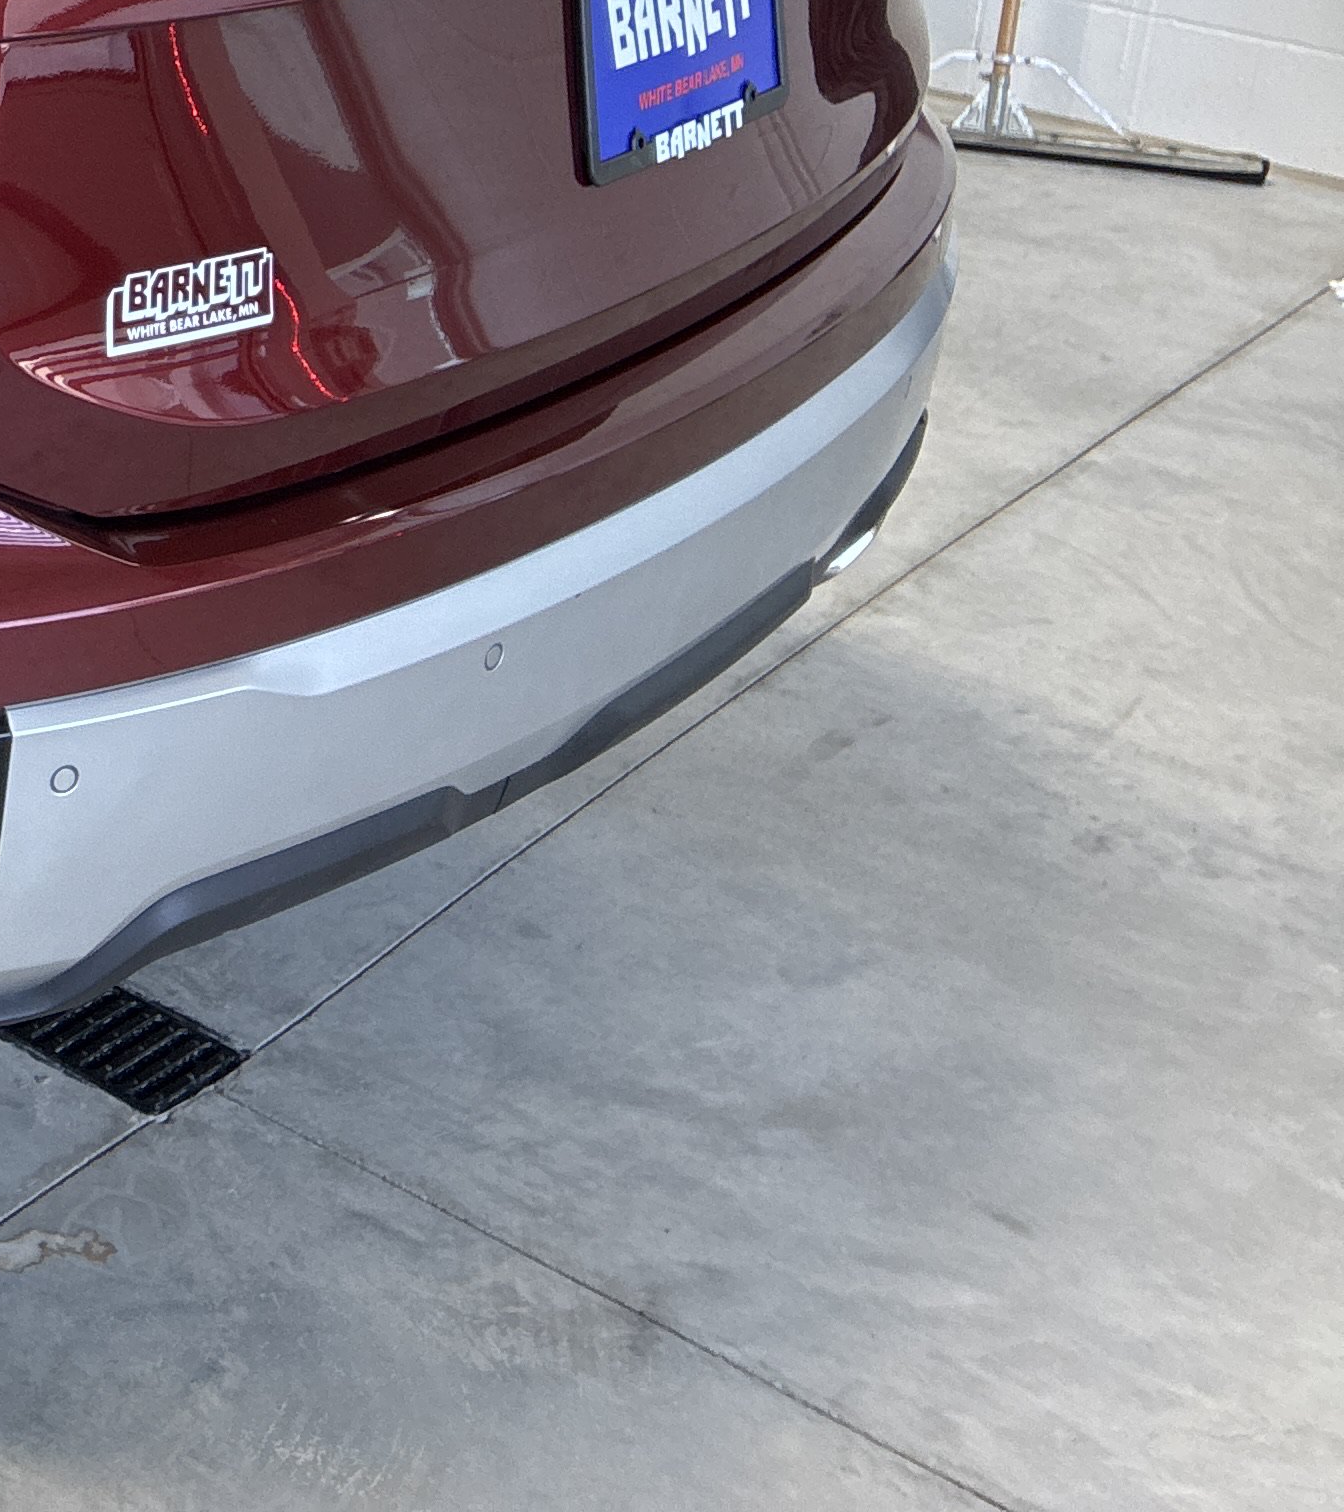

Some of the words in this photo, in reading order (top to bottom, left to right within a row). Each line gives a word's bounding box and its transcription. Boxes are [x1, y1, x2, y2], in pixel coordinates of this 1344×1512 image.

[639, 83, 673, 110] WHITE
[675, 71, 703, 98] BEAR
[655, 99, 745, 164] BARNETT
[122, 247, 266, 322] BARNETT
[127, 322, 167, 341] WHITE
[169, 315, 201, 333] BEAR
[203, 307, 237, 326] LAKE,
[238, 301, 259, 318] MN
